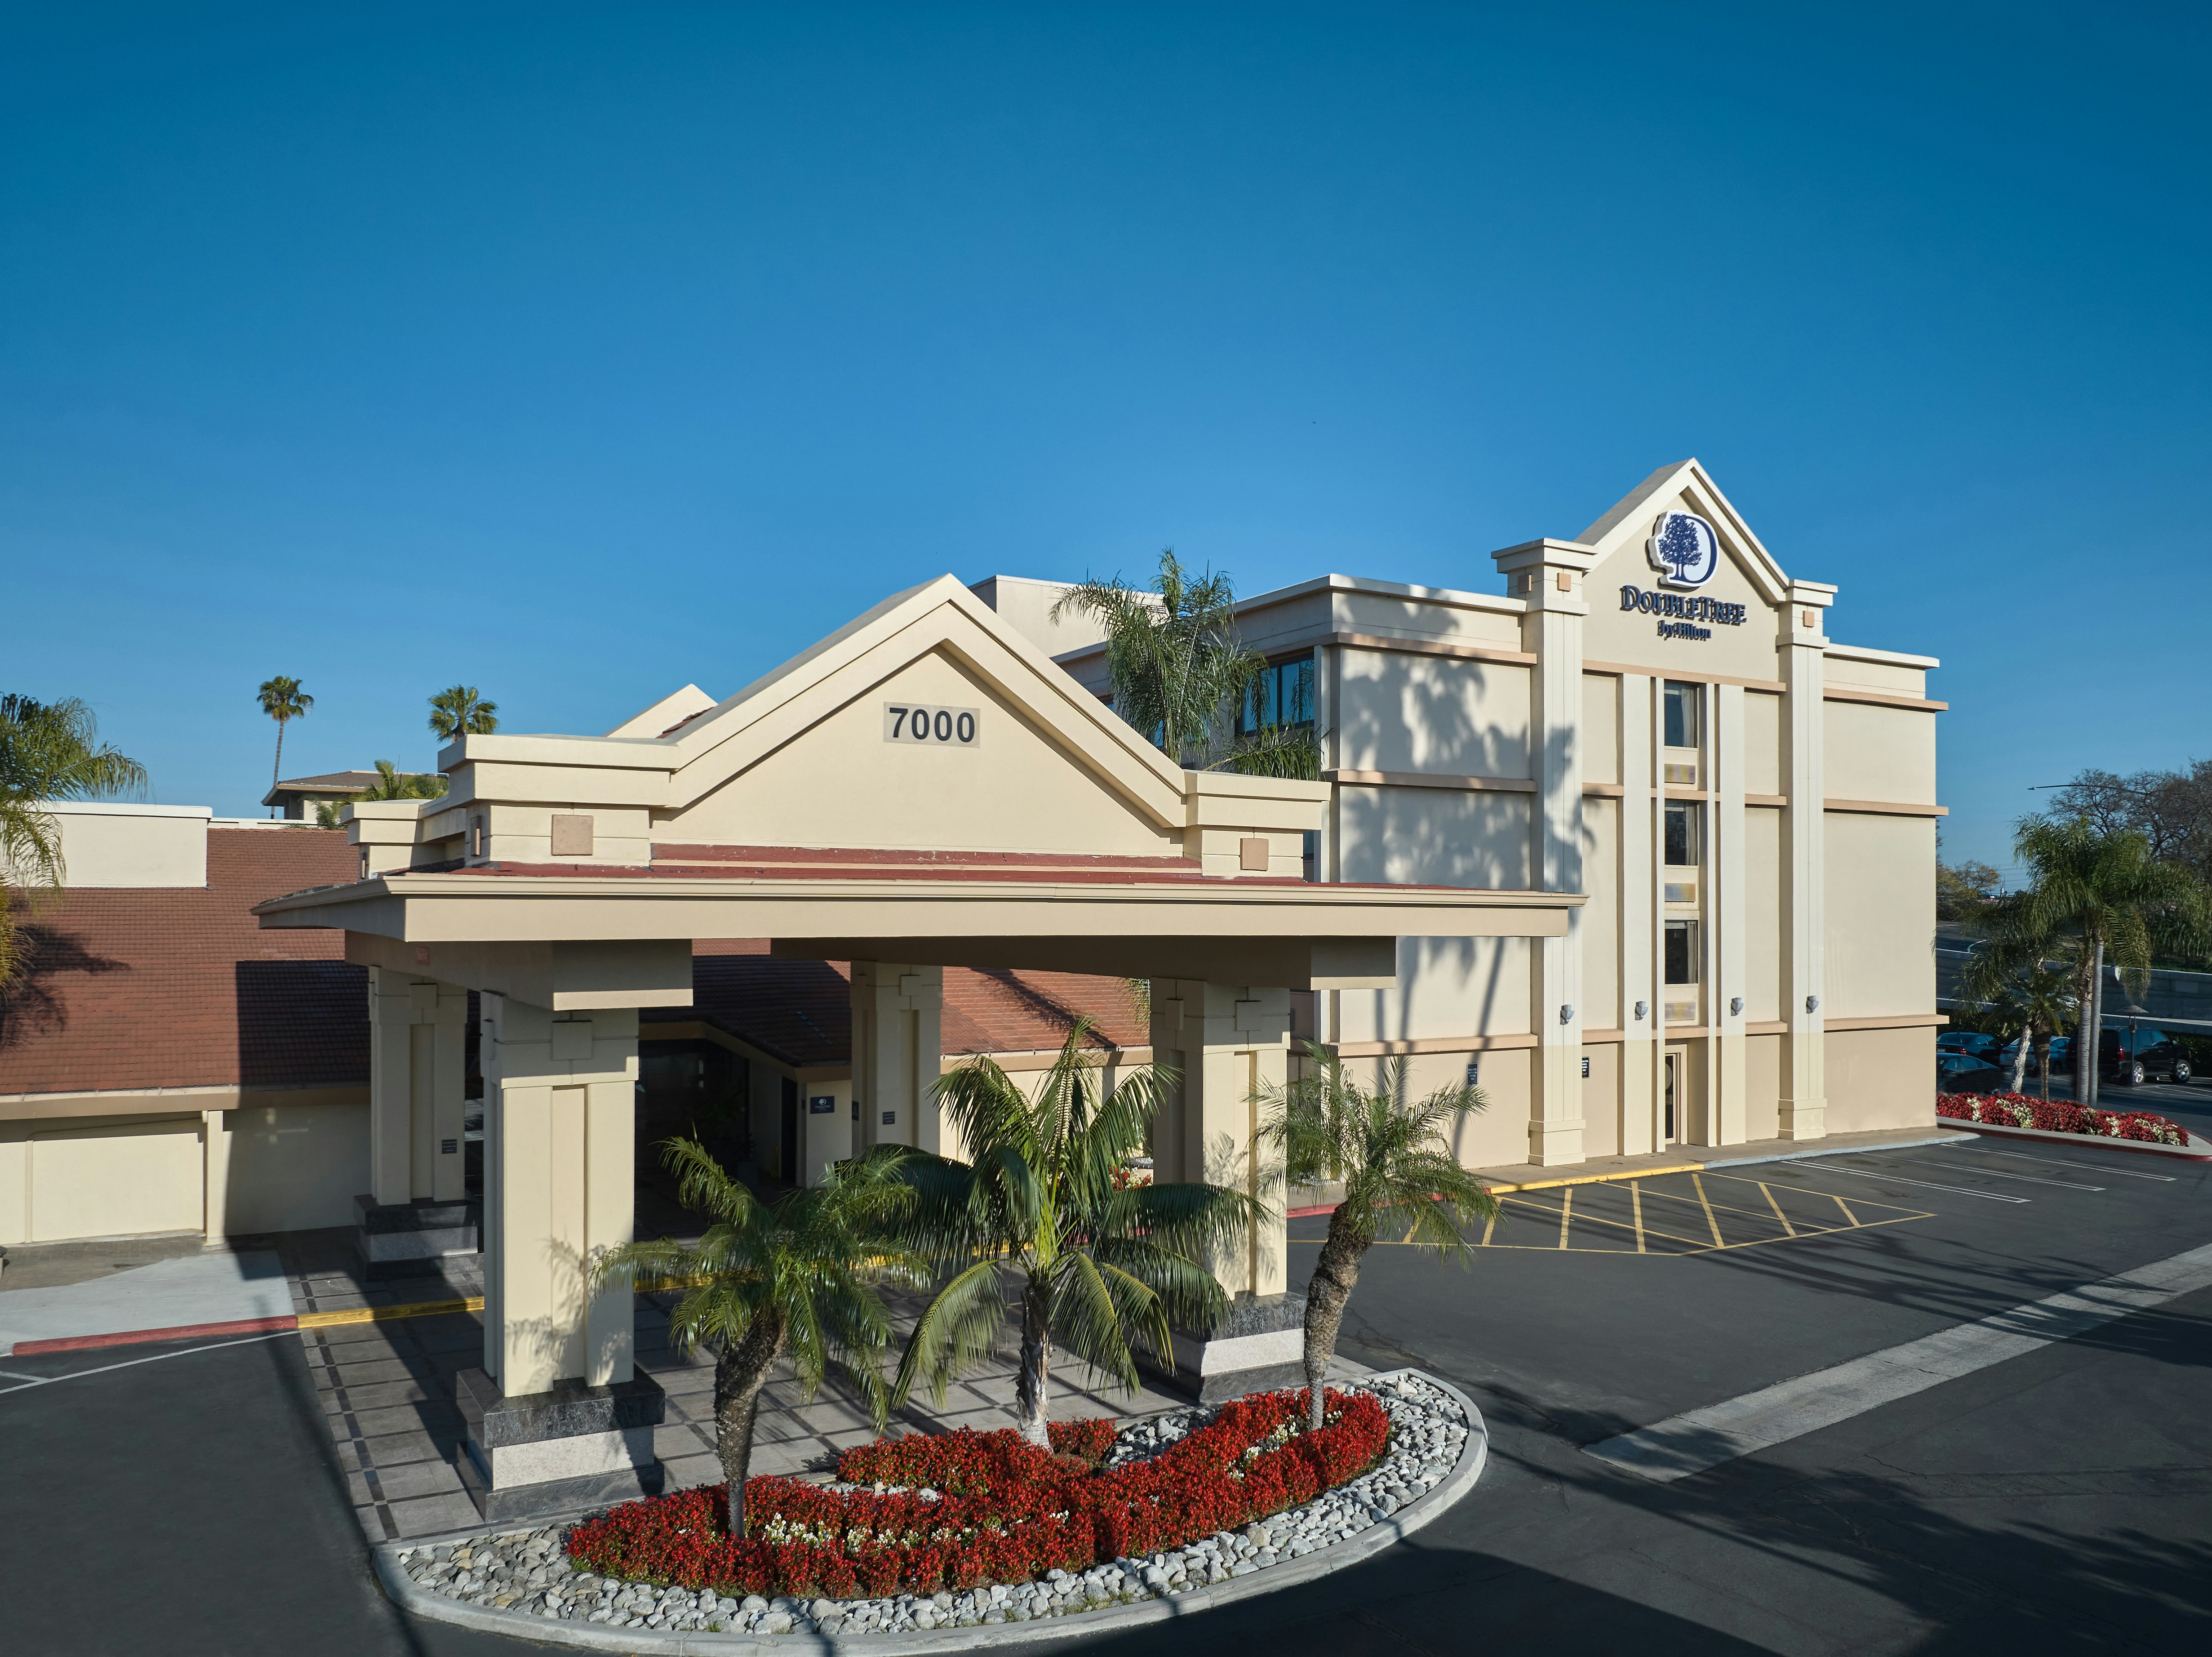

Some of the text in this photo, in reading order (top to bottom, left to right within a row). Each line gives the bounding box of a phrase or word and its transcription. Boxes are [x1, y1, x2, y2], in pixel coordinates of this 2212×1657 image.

[1660, 620, 1711, 640] by Hilton
[889, 707, 975, 742] 7000
